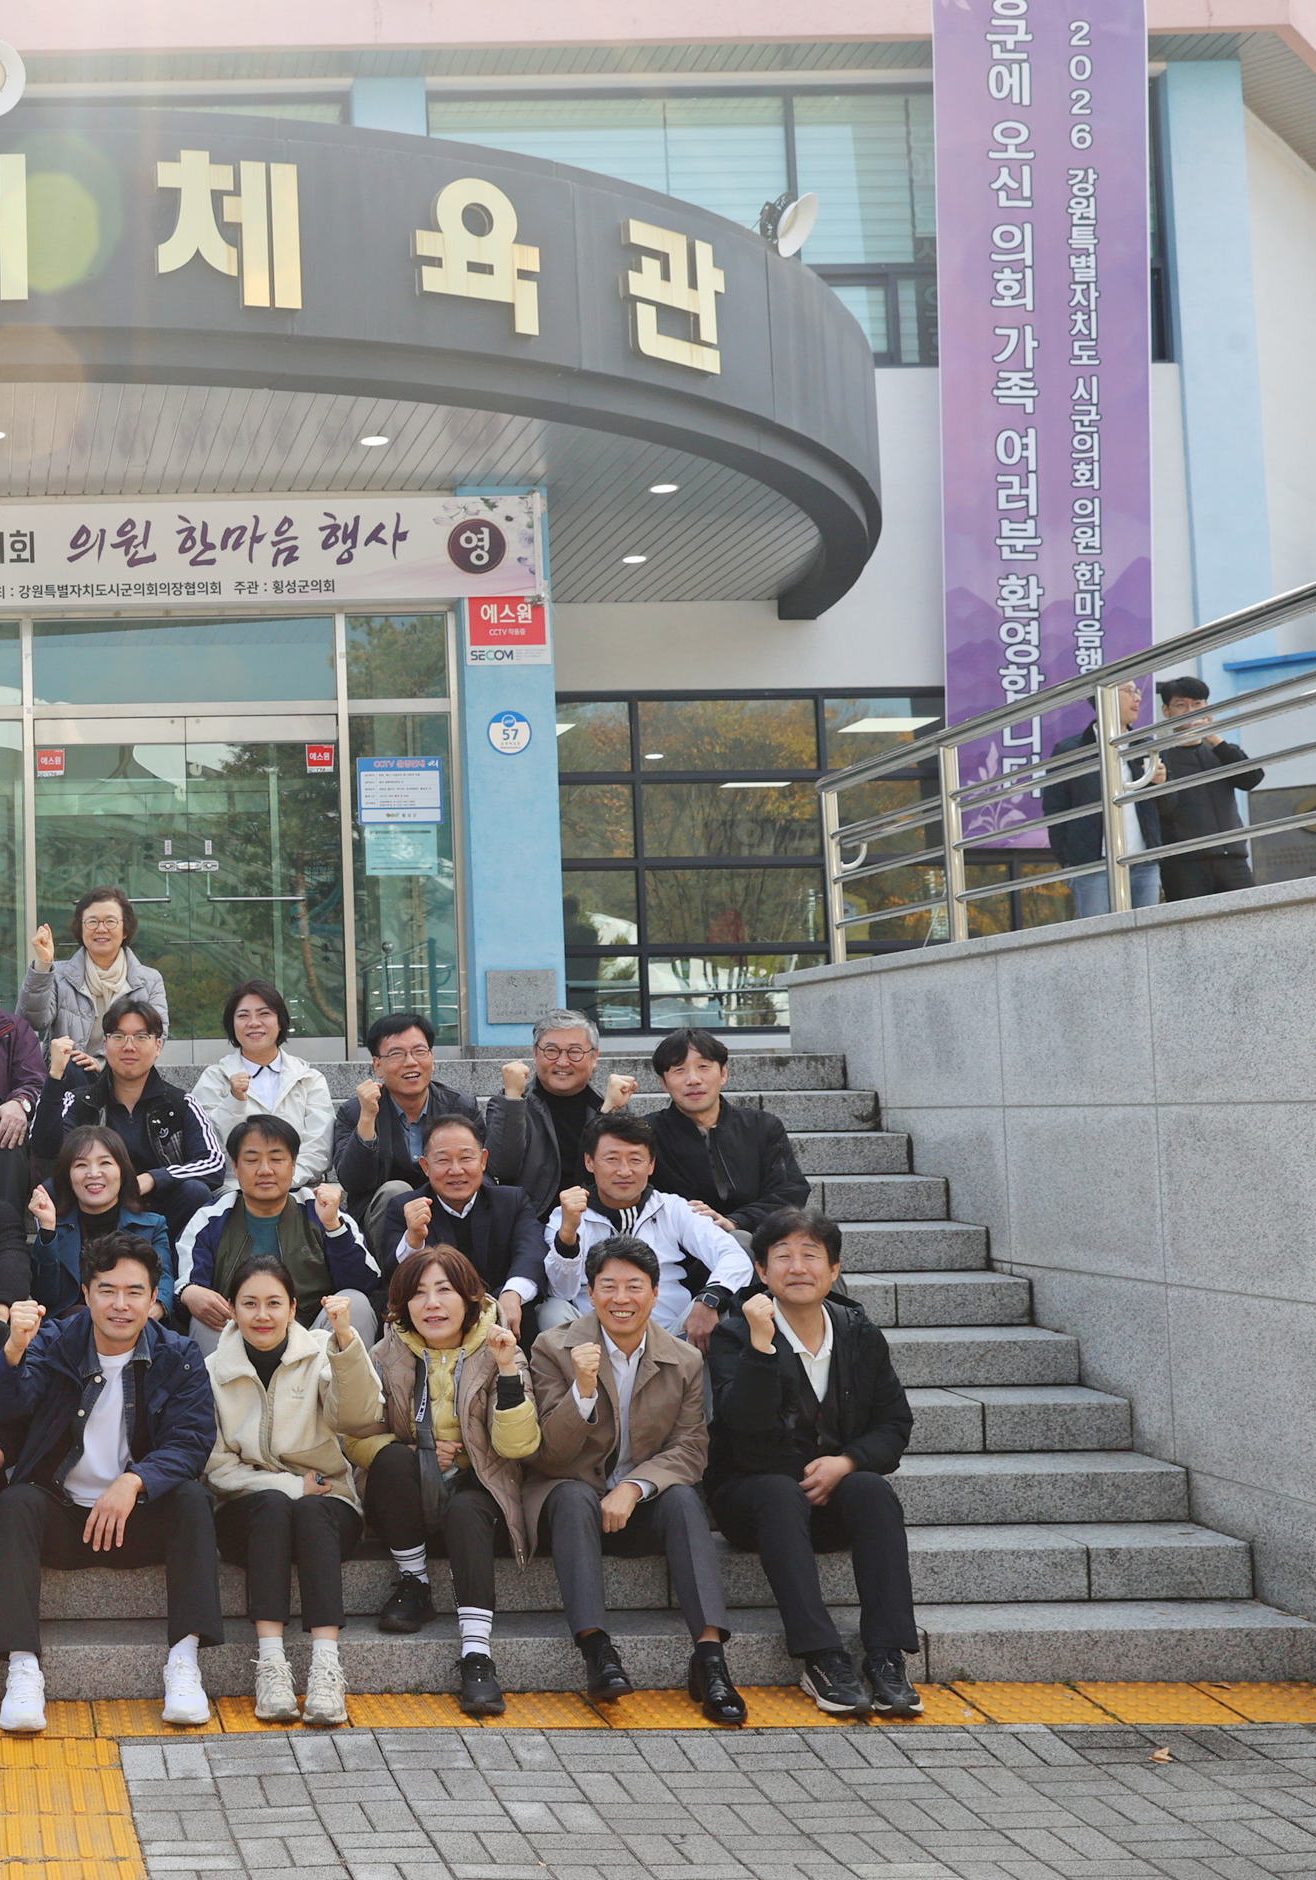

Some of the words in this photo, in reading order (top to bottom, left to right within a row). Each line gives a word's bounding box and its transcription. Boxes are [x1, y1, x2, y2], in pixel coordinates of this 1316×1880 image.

[1068, 20, 1093, 150] 2026
[987, 119, 1035, 208] 오신
[988, 221, 1036, 312] 의회
[1067, 167, 1101, 367] 강원특별자치도
[992, 325, 1038, 415] 가족
[1070, 374, 1101, 490] 시군의회
[993, 427, 1042, 561] 여러분
[66, 517, 158, 569] 의원
[177, 514, 300, 568] 한마음
[318, 511, 410, 566] 행사
[458, 529, 493, 563] 영
[1072, 496, 1103, 554] 의원
[18, 581, 222, 599] 강원특별자치도시군의회의장협의회
[234, 580, 259, 595] 주관
[272, 578, 335, 595] 횡성군의회
[480, 604, 532, 624] 에스원
[470, 650, 514, 661] SECOM
[40, 756, 61, 765] 에스원
[309, 752, 330, 760] 에스원
[502, 728, 519, 740] 57
[374, 760, 394, 768] CCTV
